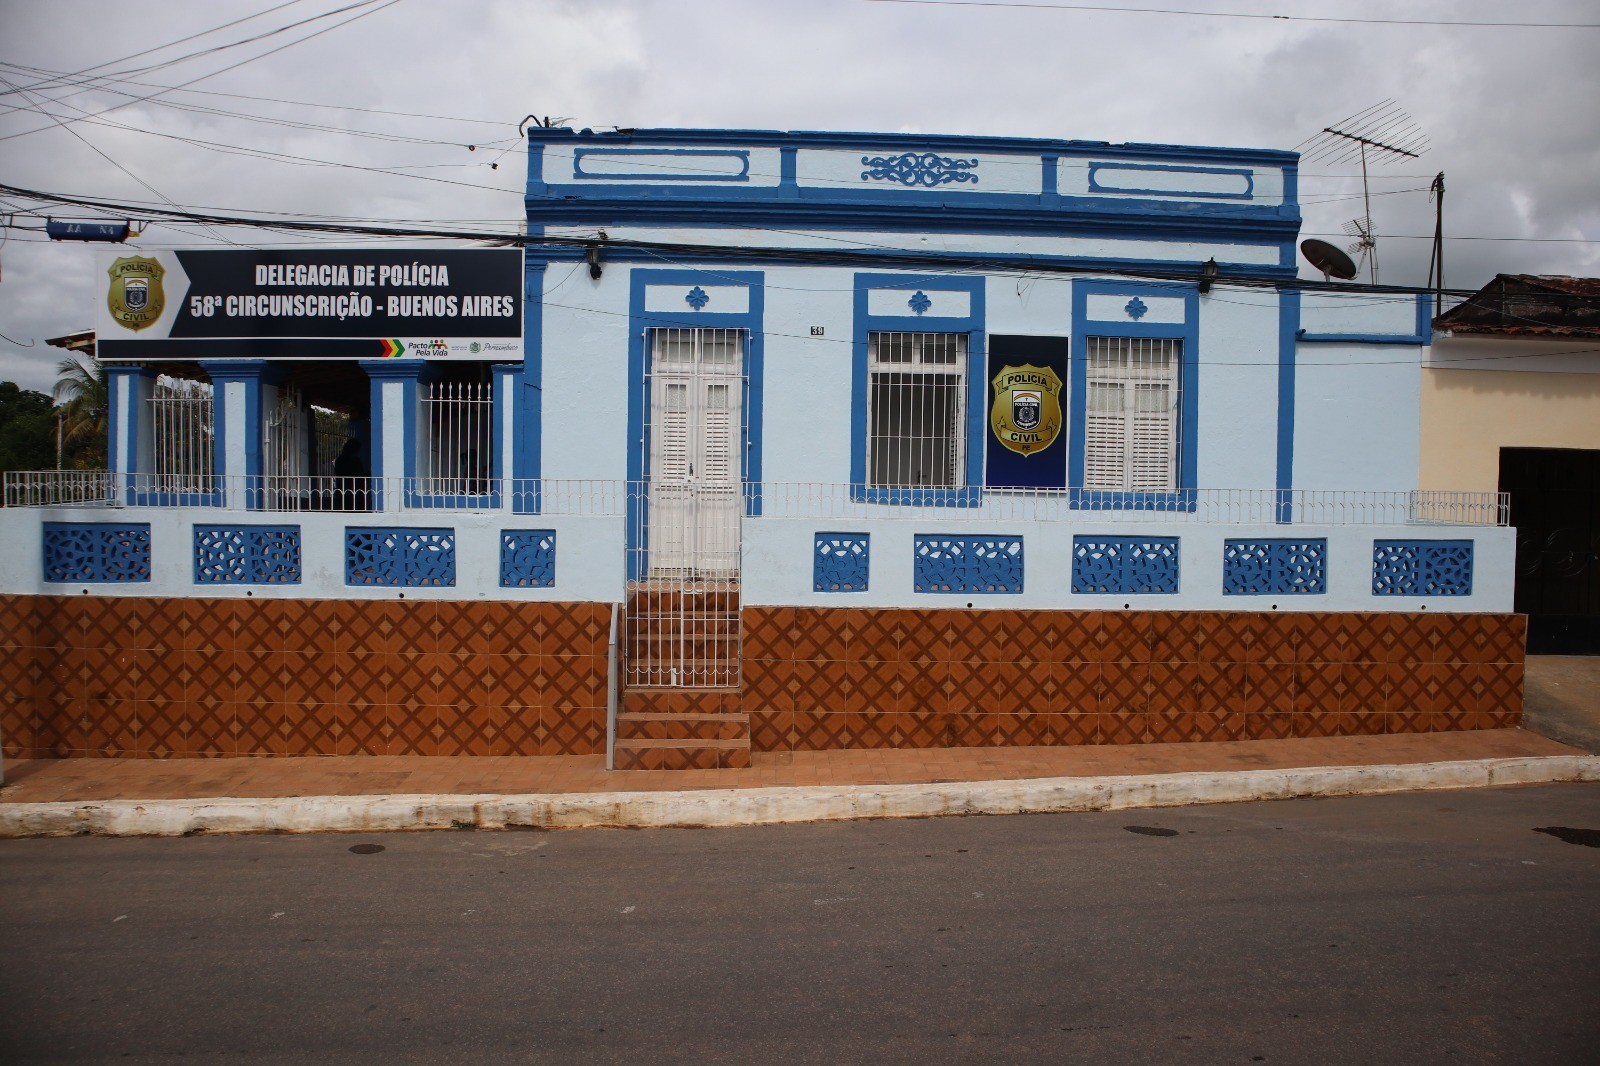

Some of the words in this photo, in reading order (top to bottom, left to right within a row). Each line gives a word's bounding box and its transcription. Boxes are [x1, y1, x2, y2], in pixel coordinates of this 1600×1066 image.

[120, 263, 154, 273] POLÍCIA
[255, 264, 350, 286] DELEGACIA
[353, 265, 376, 287] DE
[379, 261, 450, 287] POLÍCIA
[190, 295, 223, 318] 58ª
[225, 291, 373, 321] CIRCUNSCRIÇÃO
[387, 295, 459, 317] BUENOS
[461, 295, 514, 317] AIRES
[483, 342, 519, 352] Pernambuco
[1007, 372, 1048, 386] POLÍCIA
[1010, 433, 1042, 442] CIVIL
